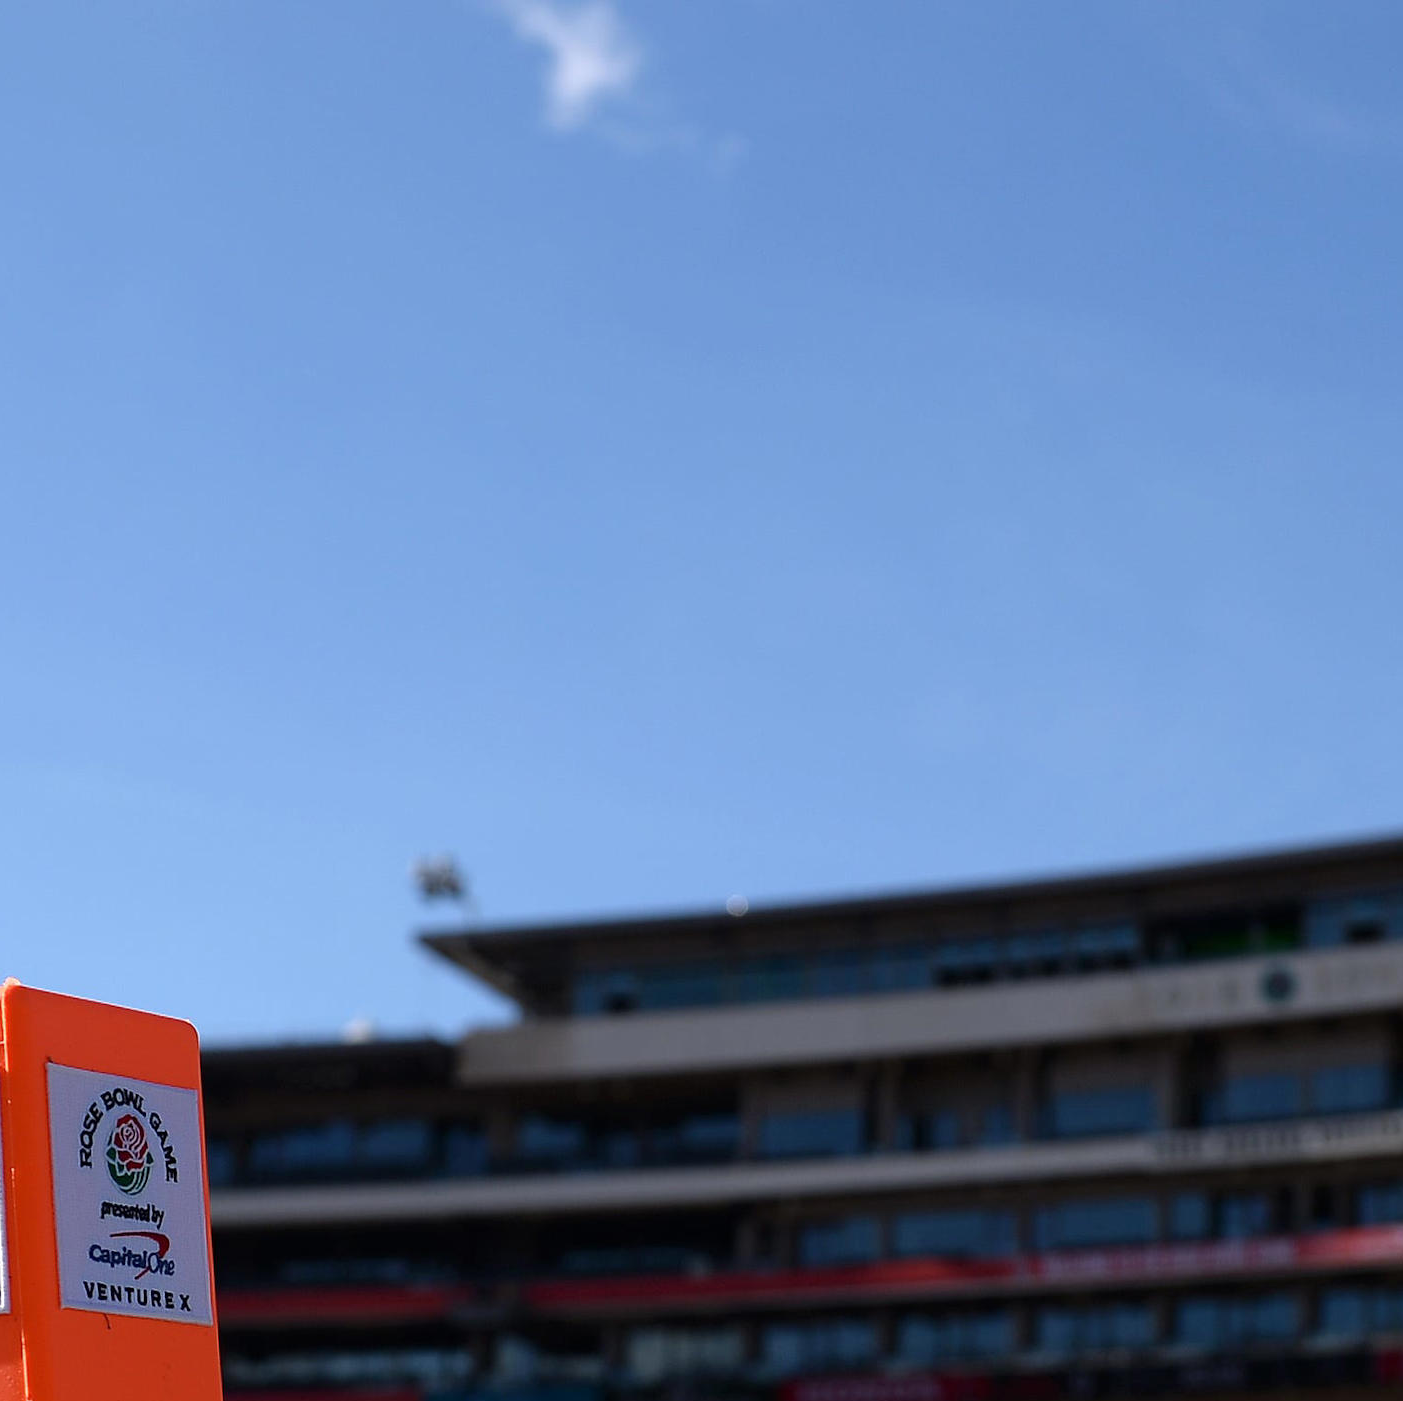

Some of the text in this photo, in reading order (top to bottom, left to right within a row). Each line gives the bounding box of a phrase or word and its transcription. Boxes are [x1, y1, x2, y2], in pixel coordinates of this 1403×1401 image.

[79, 1088, 178, 1183] ROSE BOWL GAME
[101, 1201, 165, 1230] presented by
[83, 1280, 191, 1312] VENTURE X
